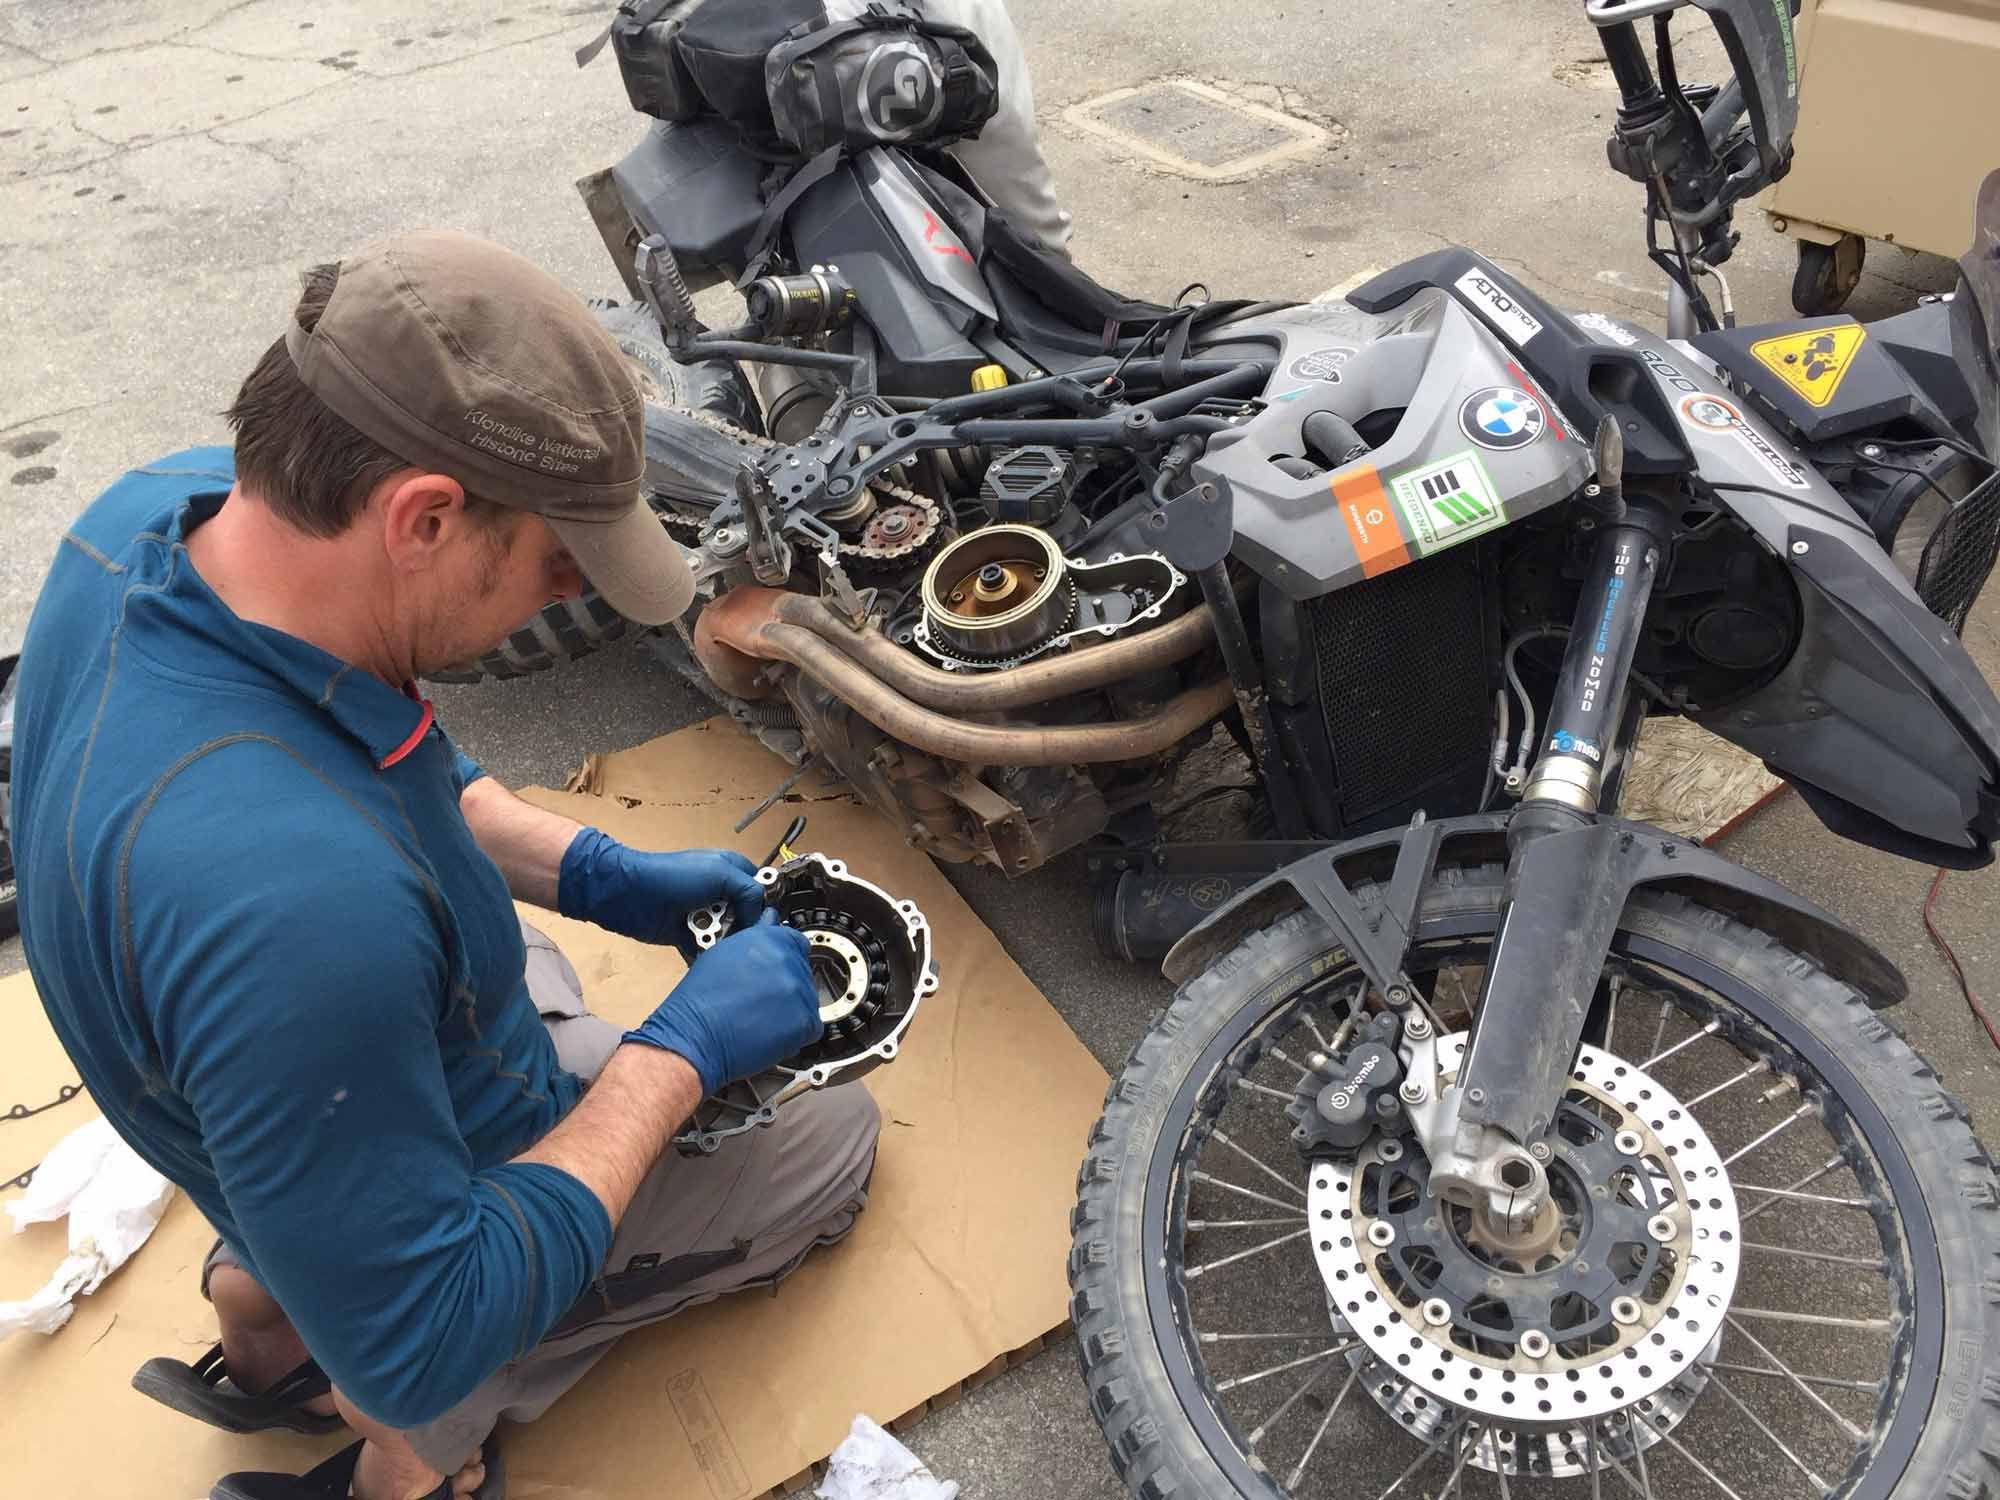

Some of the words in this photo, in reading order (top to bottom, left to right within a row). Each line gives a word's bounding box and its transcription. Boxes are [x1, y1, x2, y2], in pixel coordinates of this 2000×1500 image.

[463, 408, 536, 446] Klondike
[538, 437, 601, 460] National
[471, 432, 537, 463] Historic
[539, 455, 580, 473] Sites
[1614, 544, 1631, 576] TWO
[1580, 655, 1605, 713] NOMAD
[1343, 1055, 1380, 1095] brembo
